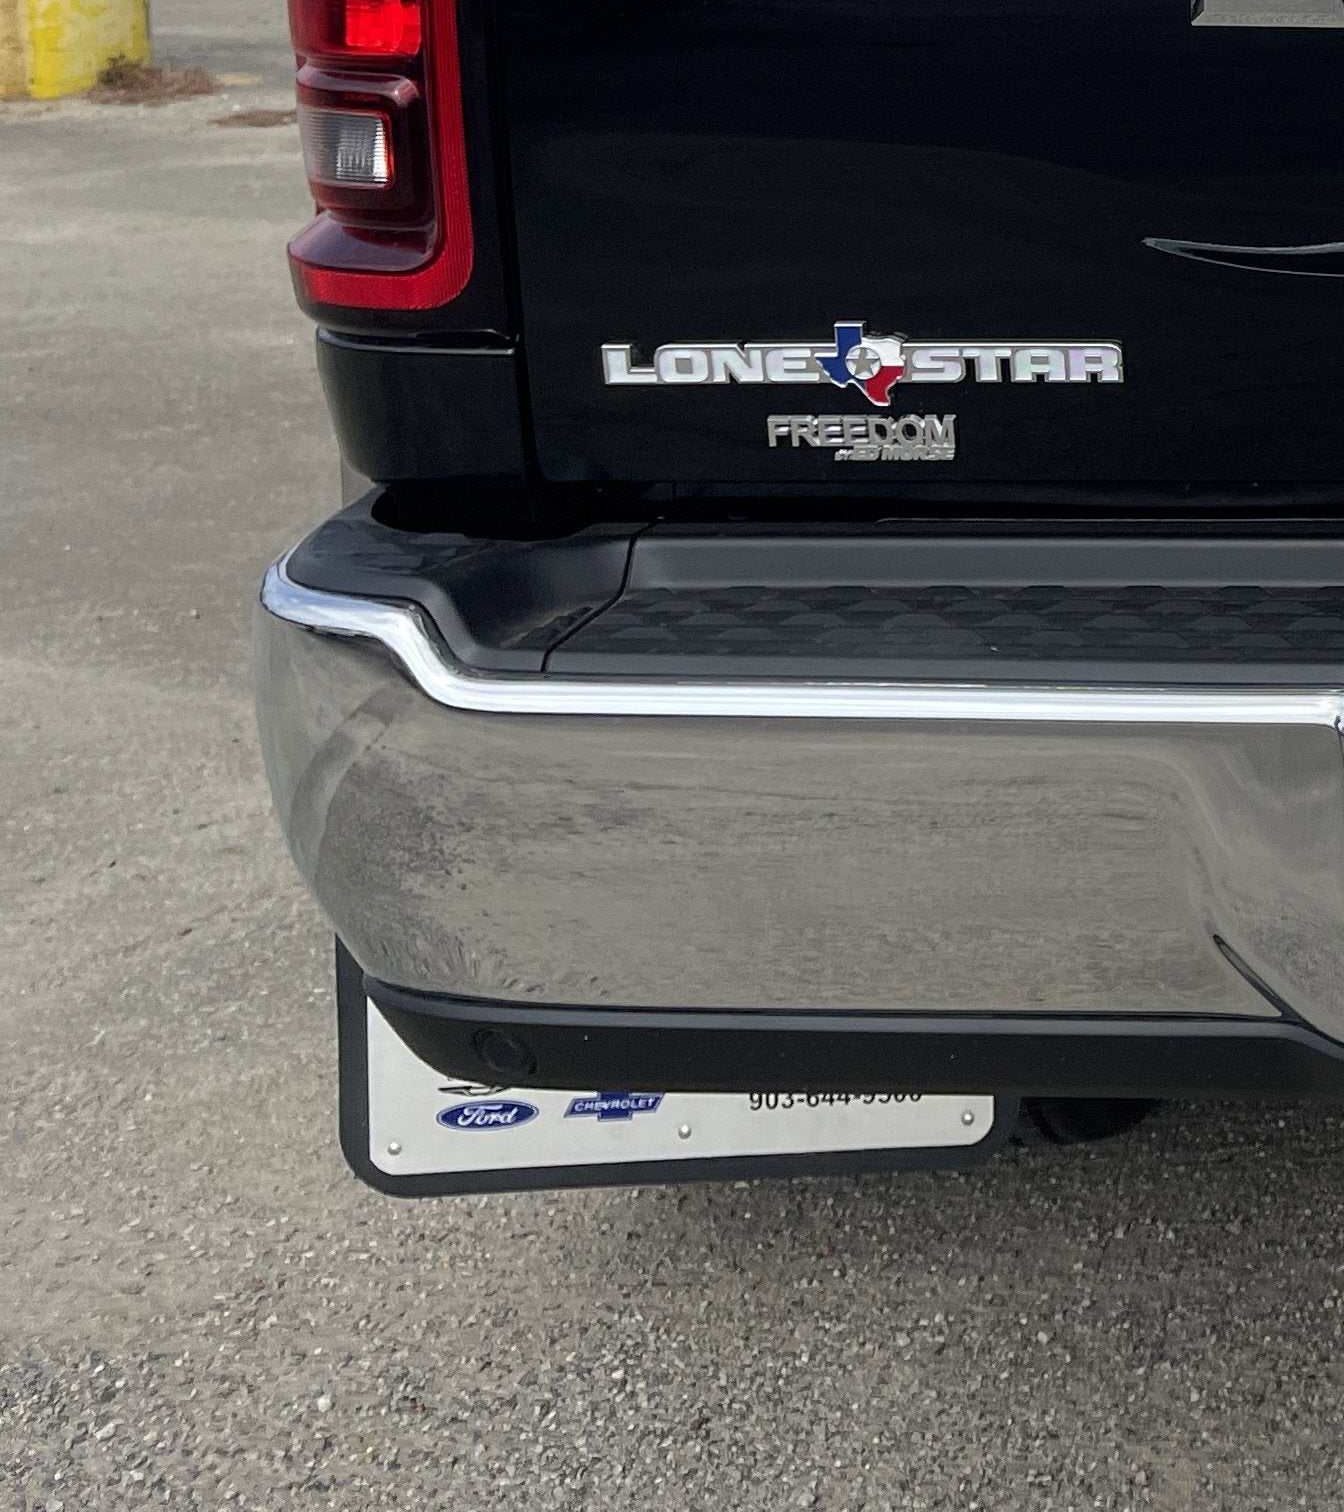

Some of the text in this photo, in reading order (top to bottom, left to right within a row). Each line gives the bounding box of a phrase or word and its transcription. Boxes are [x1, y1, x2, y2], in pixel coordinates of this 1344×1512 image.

[601, 340, 1124, 385] LONE STAR
[767, 414, 957, 447] FREEDOM
[456, 1103, 519, 1127] Ford
[573, 1097, 655, 1112] CHEVROLET
